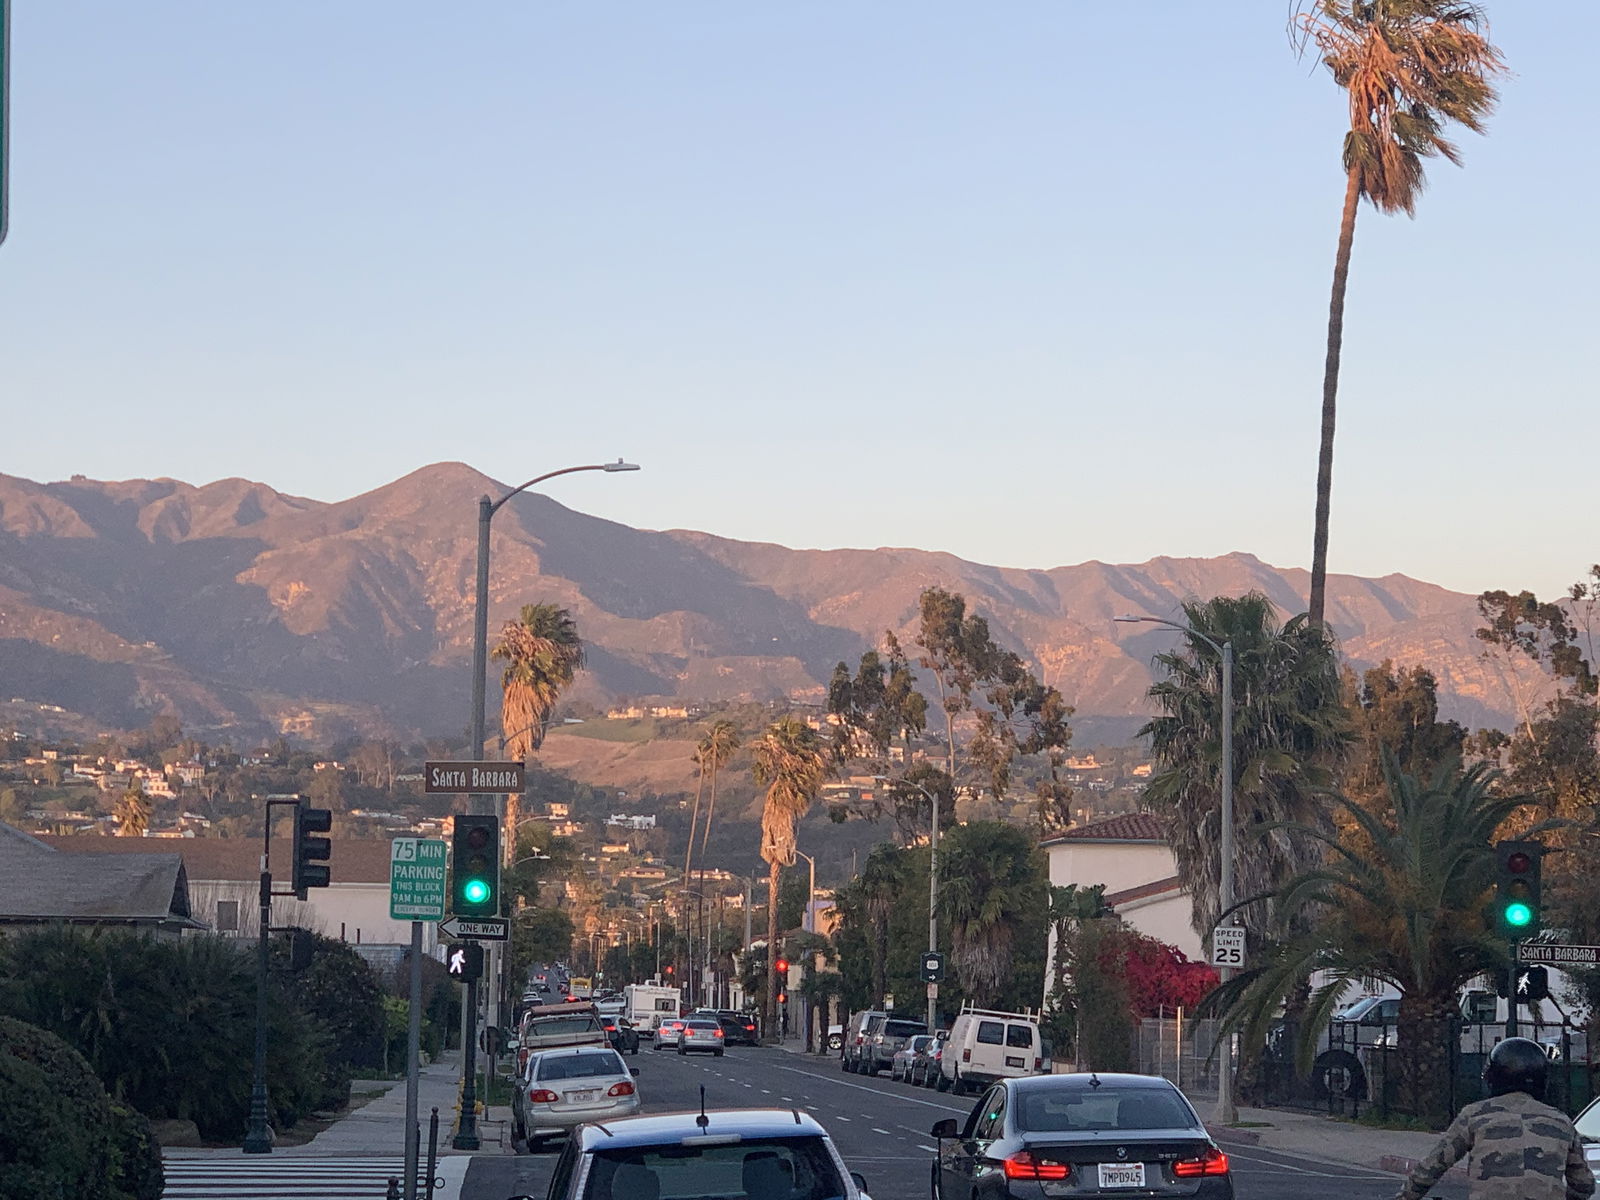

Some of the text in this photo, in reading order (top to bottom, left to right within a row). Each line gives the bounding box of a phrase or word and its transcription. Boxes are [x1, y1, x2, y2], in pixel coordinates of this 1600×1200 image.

[432, 767, 518, 787] SANTA BARBARA
[394, 841, 442, 859] 75 MIN
[394, 865, 443, 880] PARKING
[396, 881, 441, 892] THIS BLOCK
[392, 893, 442, 905] 9AM to 6PM
[459, 923, 502, 934] ONE WAY
[1215, 930, 1244, 938] SPEED
[1215, 948, 1241, 963] 25
[1521, 946, 1597, 961] SANTA BARBARA
[1102, 1172, 1142, 1183] 7MPD945
